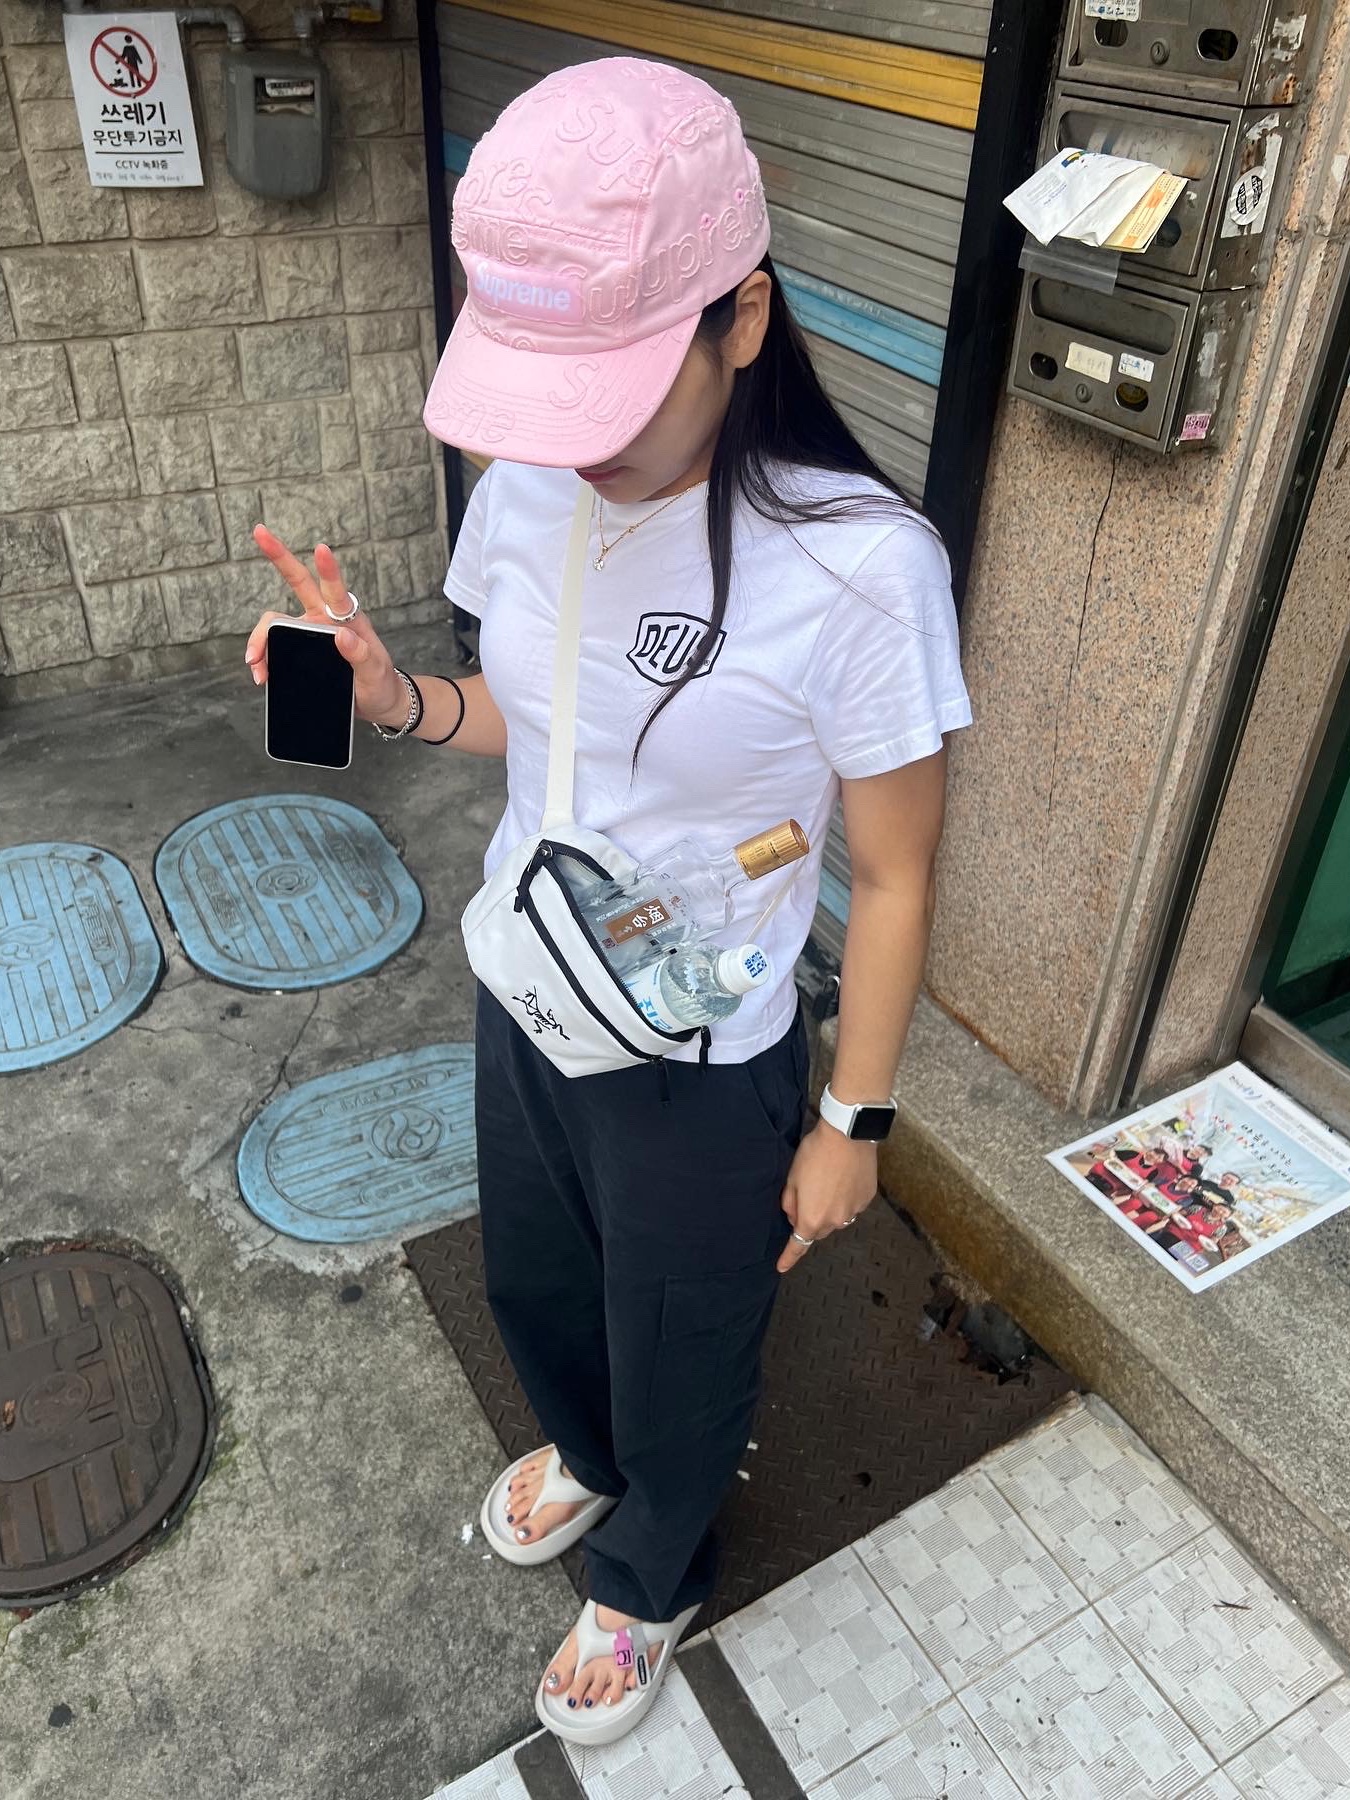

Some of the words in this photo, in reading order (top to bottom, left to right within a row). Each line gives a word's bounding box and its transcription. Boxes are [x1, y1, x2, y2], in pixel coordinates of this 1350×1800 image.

[101, 101, 166, 126] 쓰레기
[93, 129, 182, 147] 무단투기금지
[115, 160, 140, 169] CCTV
[474, 260, 572, 313] Supreme
[634, 623, 706, 674] DEU
